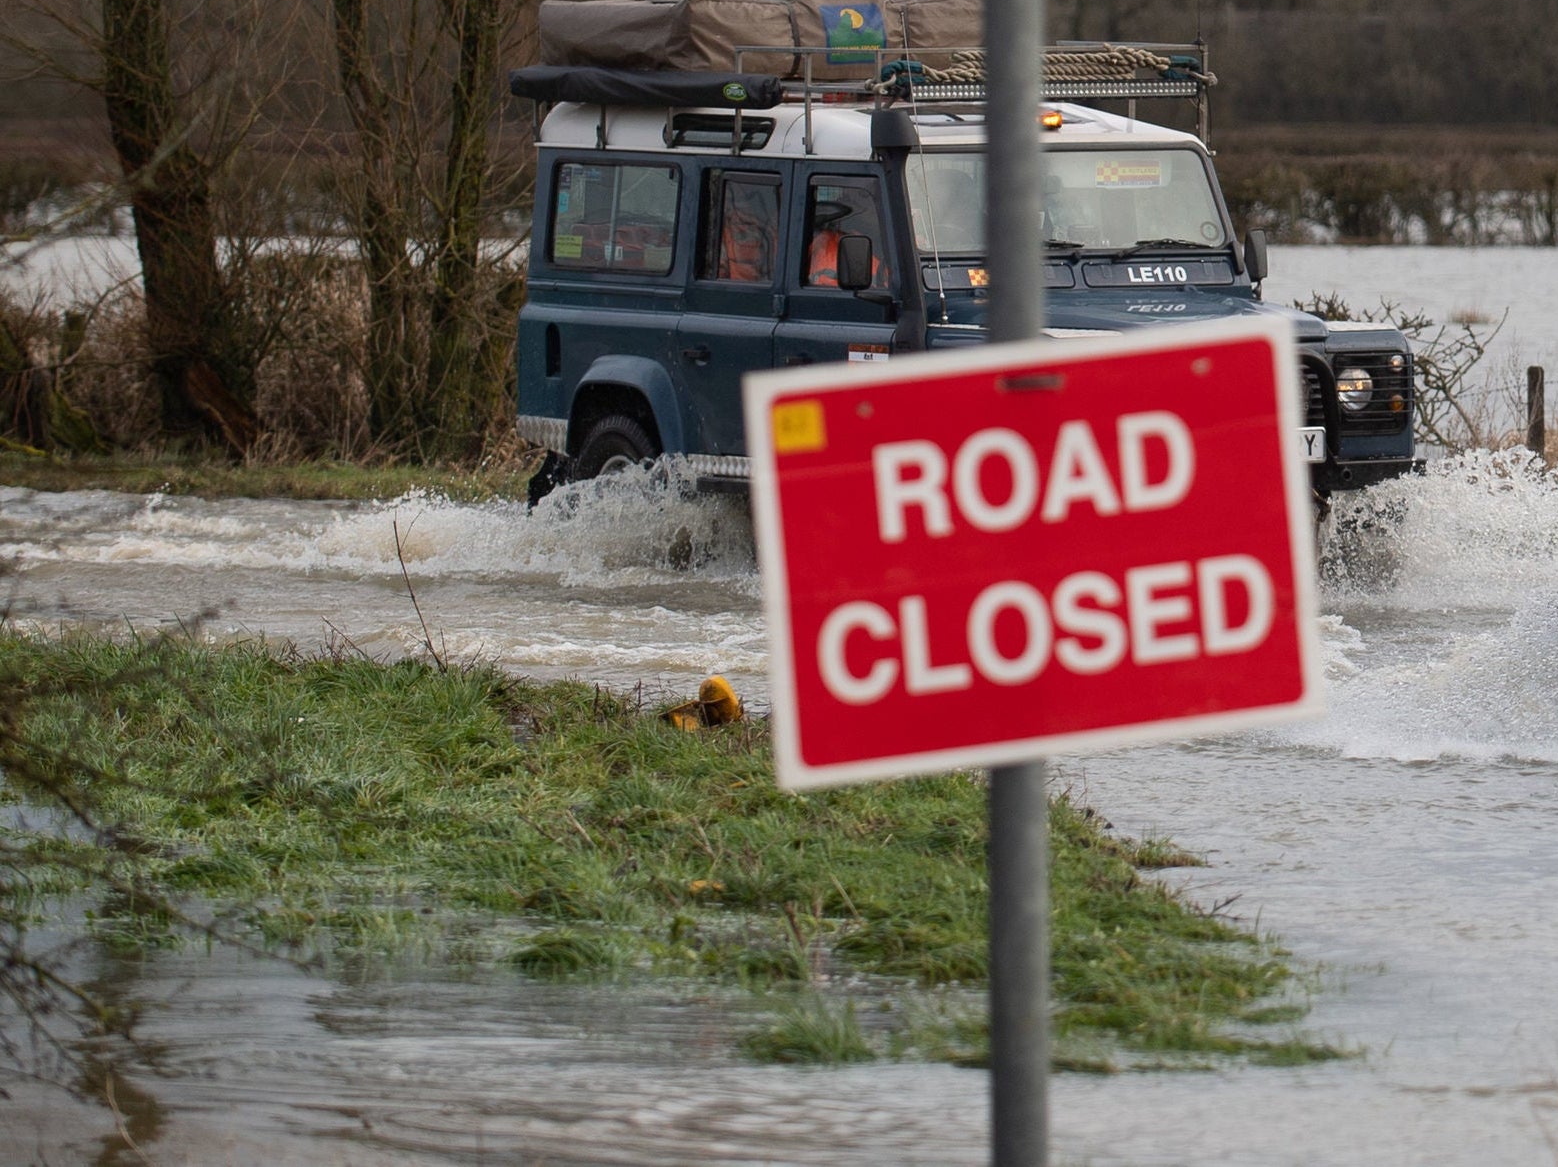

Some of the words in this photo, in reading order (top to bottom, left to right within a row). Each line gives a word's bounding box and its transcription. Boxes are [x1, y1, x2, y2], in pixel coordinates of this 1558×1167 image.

[1127, 266, 1187, 282] LE110
[871, 410, 1196, 544] ROAD
[817, 553, 1276, 706] CLOSED
